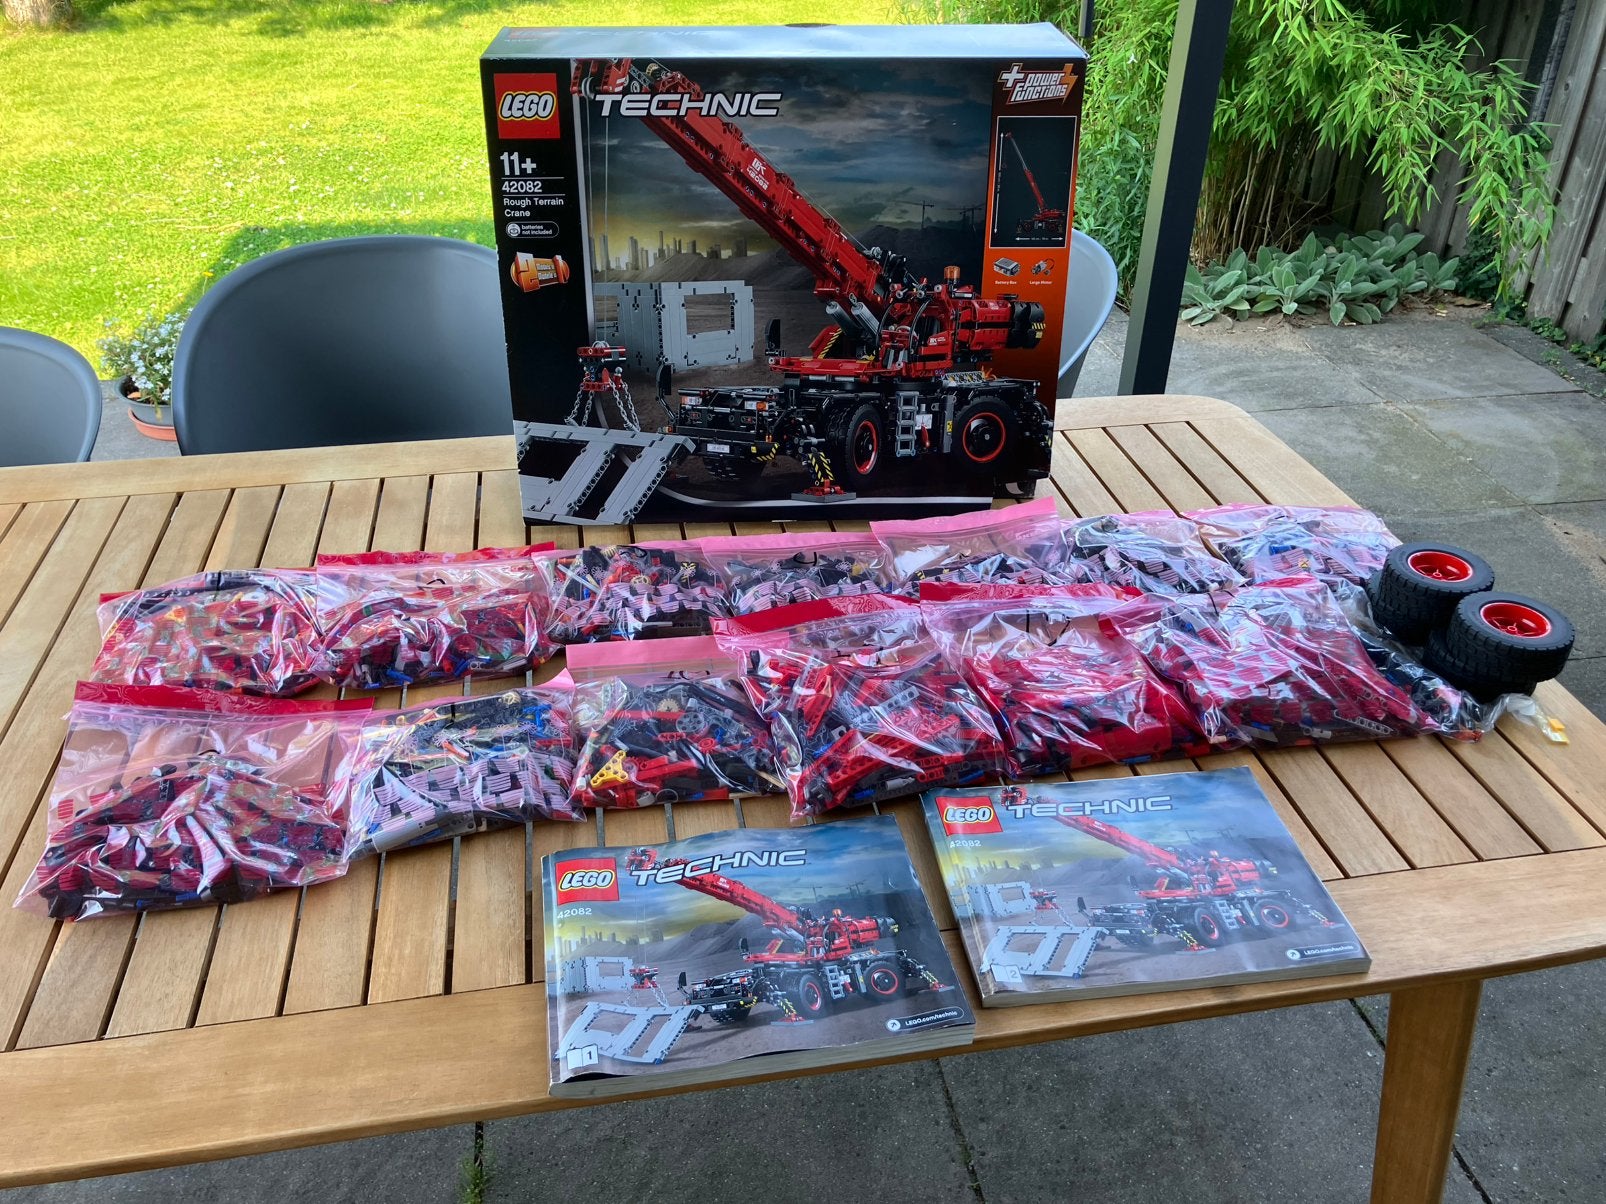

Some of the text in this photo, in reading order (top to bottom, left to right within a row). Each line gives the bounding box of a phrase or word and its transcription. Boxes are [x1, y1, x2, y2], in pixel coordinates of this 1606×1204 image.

[500, 92, 556, 119] LEGO
[595, 92, 782, 117] TECHNIC
[500, 152, 537, 175] 11+
[501, 181, 543, 193] 42082
[503, 197, 564, 207] Rough Terrain
[504, 209, 531, 217] Crane
[945, 806, 994, 823] LEGO
[1007, 795, 1173, 819] TECHNIC
[950, 840, 982, 849] 42082
[631, 849, 807, 886] TECHNIC
[559, 869, 615, 891] LEGO
[556, 907, 592, 919] 42082
[1010, 970, 1019, 979] 2
[904, 1010, 958, 1026] LEGO.com/technic
[586, 1050, 592, 1060] 1
